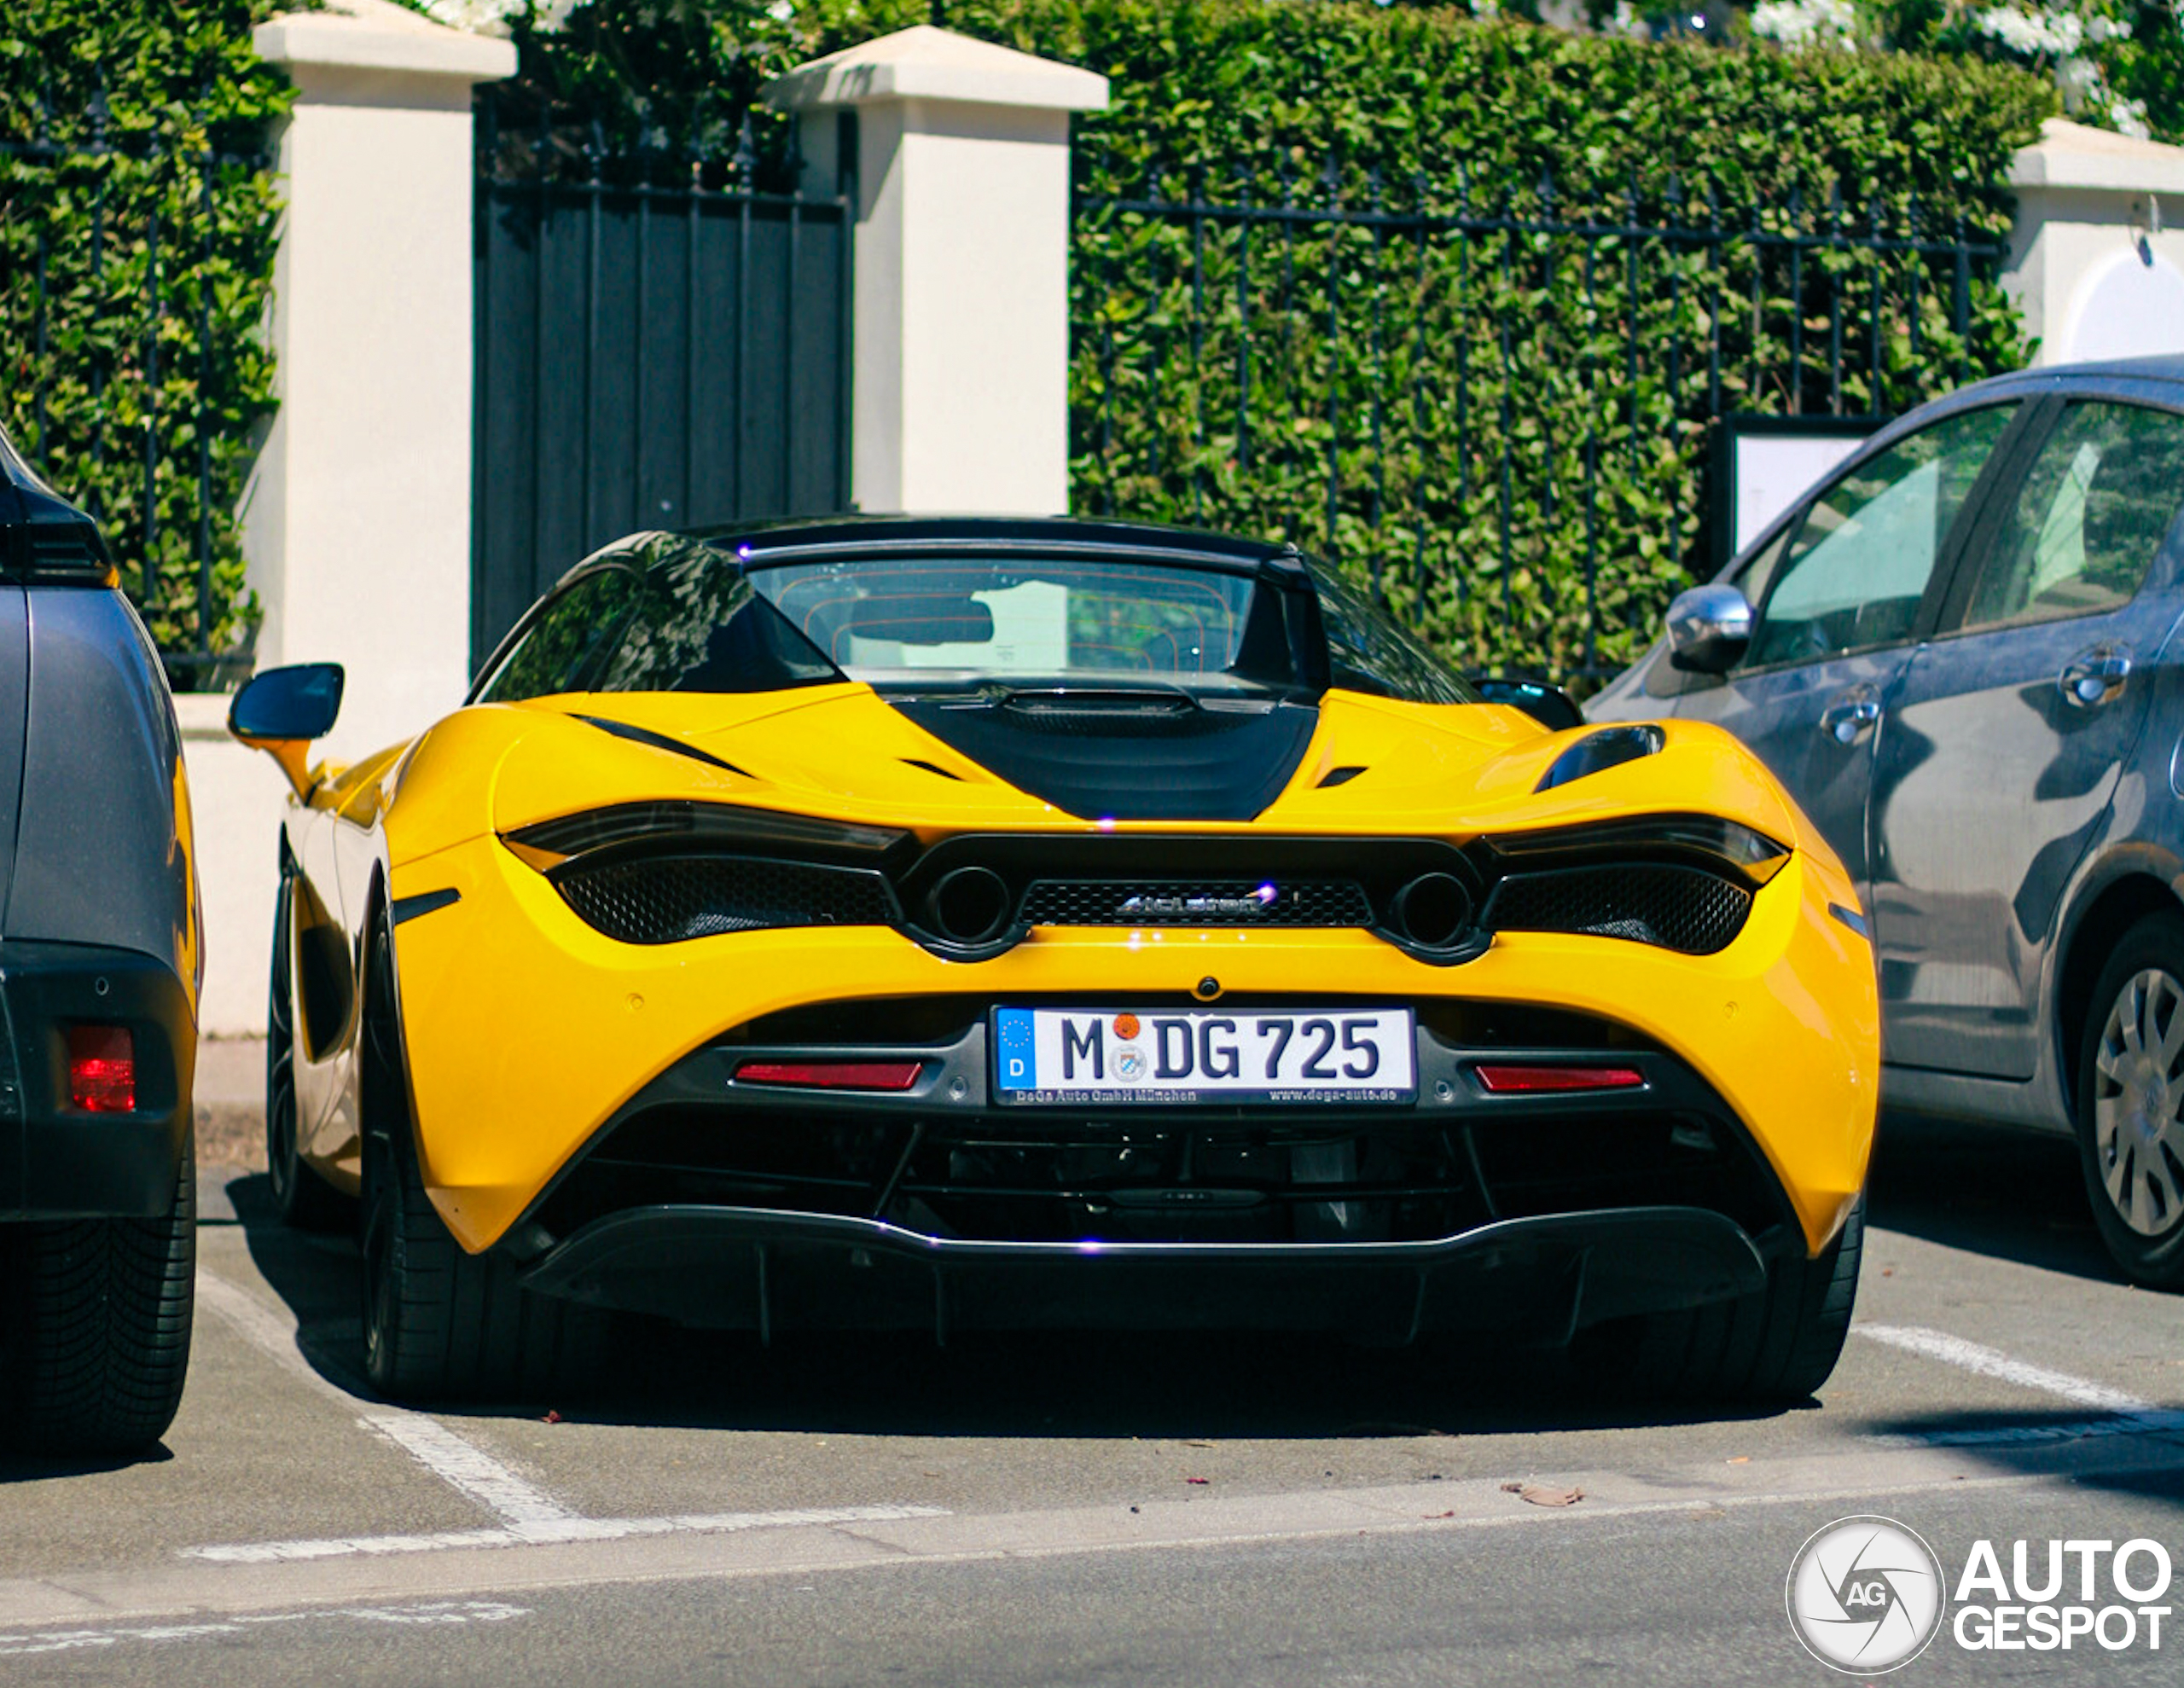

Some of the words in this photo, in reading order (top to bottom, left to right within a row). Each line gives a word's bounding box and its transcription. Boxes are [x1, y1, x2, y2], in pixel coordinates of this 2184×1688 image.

[1061, 1018, 1103, 1080] M
[1153, 1018, 1240, 1079] DG
[1257, 1018, 1380, 1079] 725
[1009, 1059, 1025, 1076] D
[1055, 1089, 1089, 1102] Auto
[1091, 1089, 1133, 1102] GmbH
[1135, 1089, 1197, 1102] München
